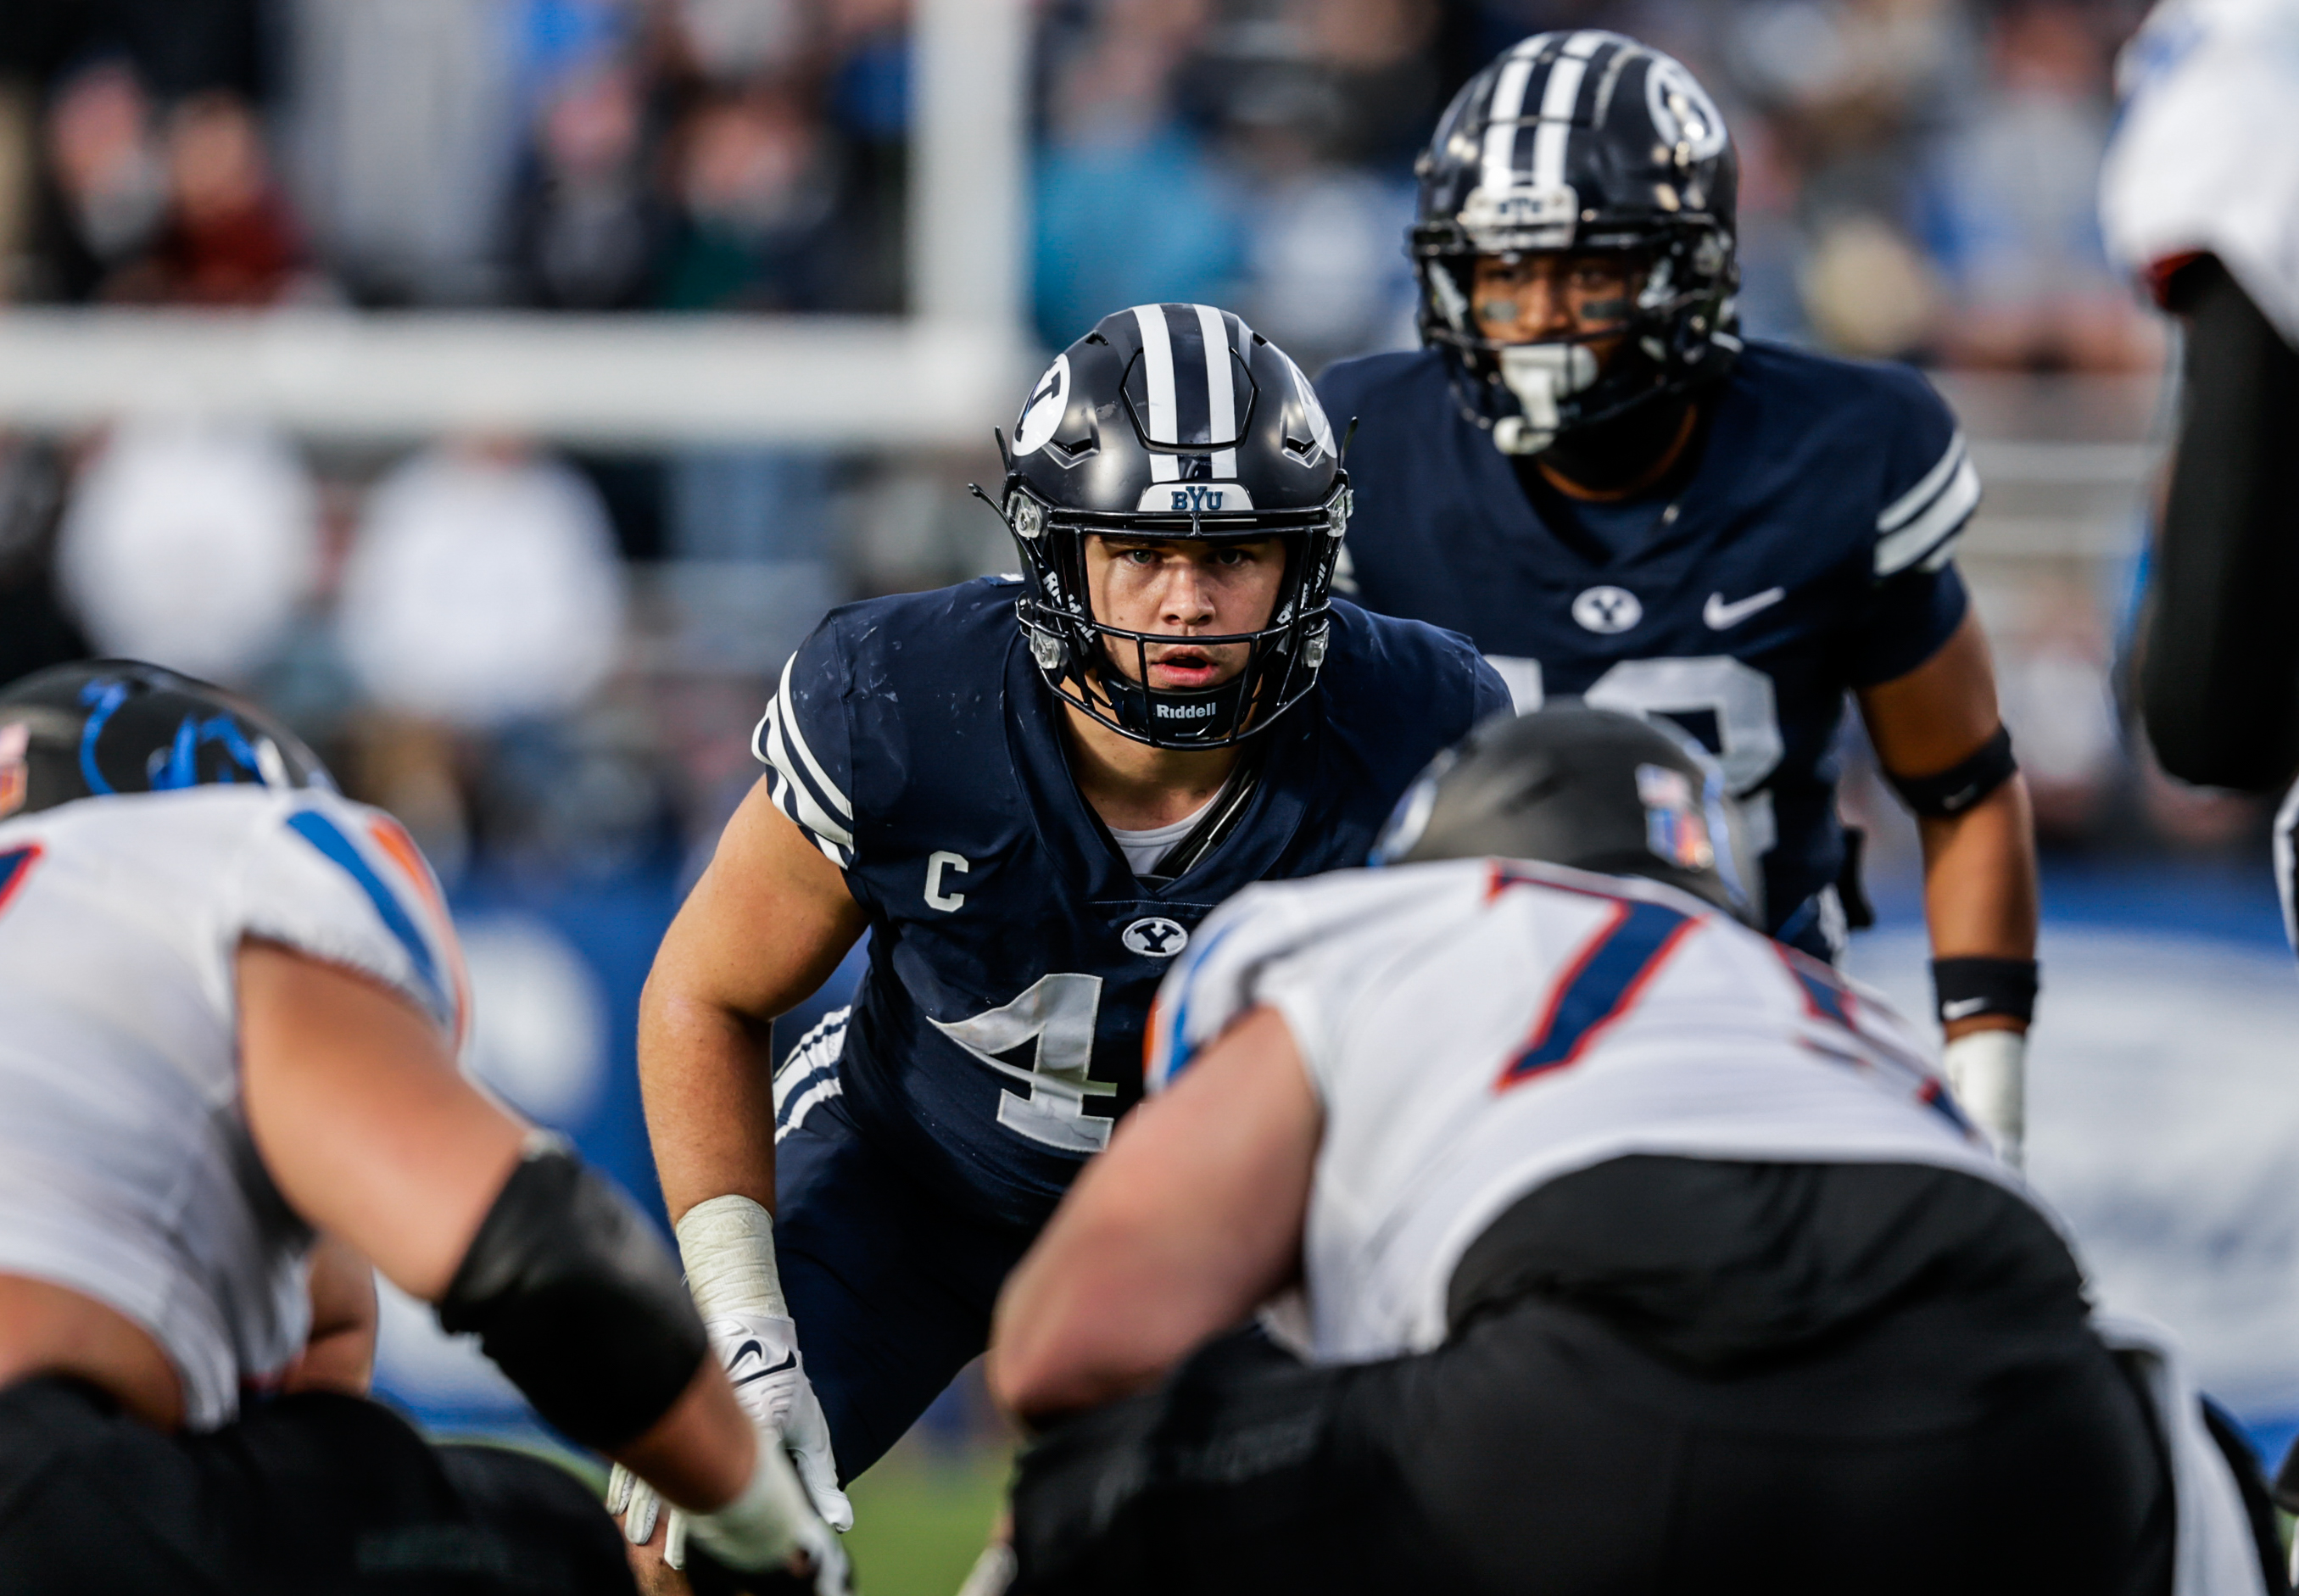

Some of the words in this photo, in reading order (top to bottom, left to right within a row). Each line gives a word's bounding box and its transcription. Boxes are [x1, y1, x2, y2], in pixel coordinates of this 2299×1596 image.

[1171, 485, 1223, 511] BYU
[1156, 701, 1217, 719] Riddell
[924, 851, 968, 912] C
[1134, 922, 1180, 953] Y
[926, 973, 1118, 1152] 4
